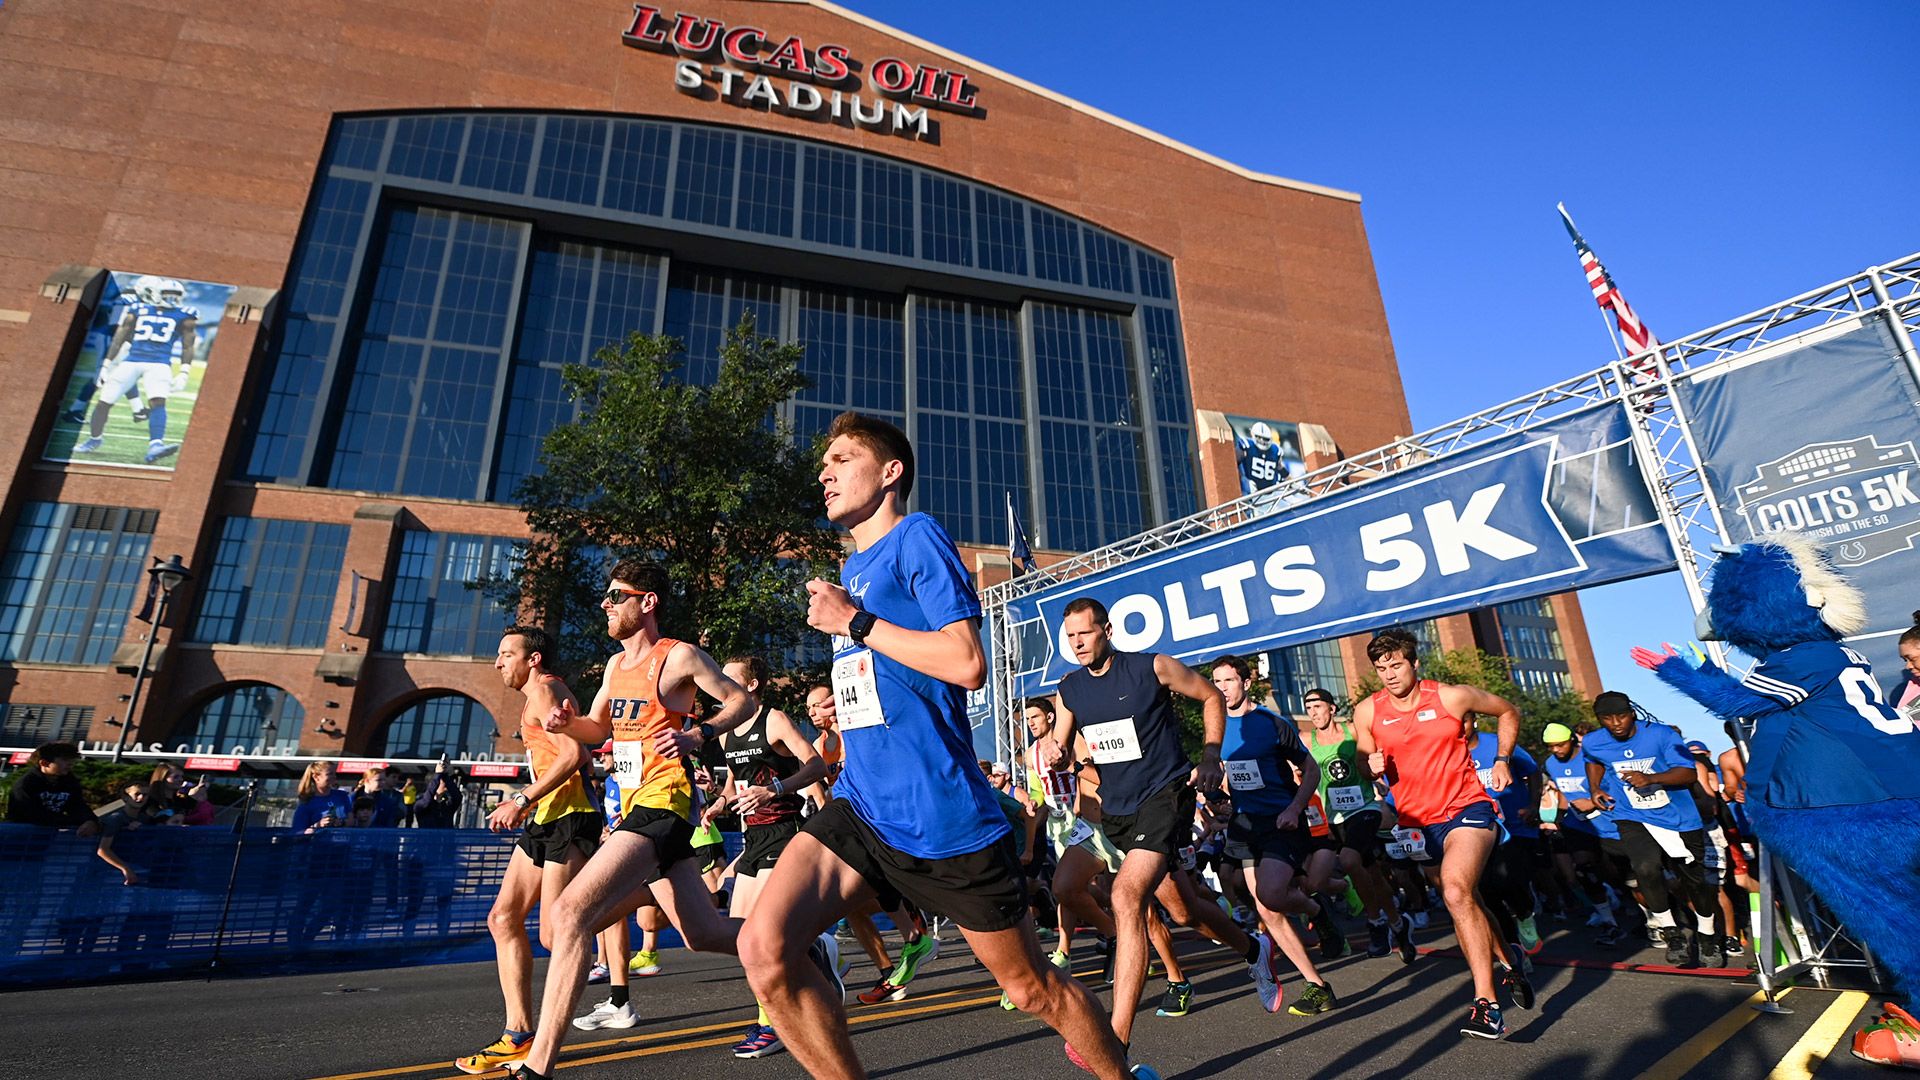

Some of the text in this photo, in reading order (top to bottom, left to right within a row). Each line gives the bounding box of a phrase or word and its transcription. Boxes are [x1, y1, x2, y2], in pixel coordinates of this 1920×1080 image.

[622, 3, 978, 110] LUCAS OIL
[674, 60, 930, 139] STADIUM
[134, 315, 176, 343] 53
[1251, 456, 1277, 481] 56
[1757, 470, 1920, 534] COLTS 5K
[1835, 522, 1851, 535] ON
[1849, 518, 1872, 531] THE
[1873, 514, 1889, 525] 50
[1359, 483, 1538, 591] 5K
[840, 685, 858, 707] 144
[609, 698, 649, 720] BT
[231, 746, 294, 758] GATE
[1098, 738, 1125, 751] 4109
[459, 751, 529, 764] NORT
[735, 756, 750, 764] ELITE
[1232, 772, 1252, 782] 3553
[1335, 796, 1355, 804] 2478
